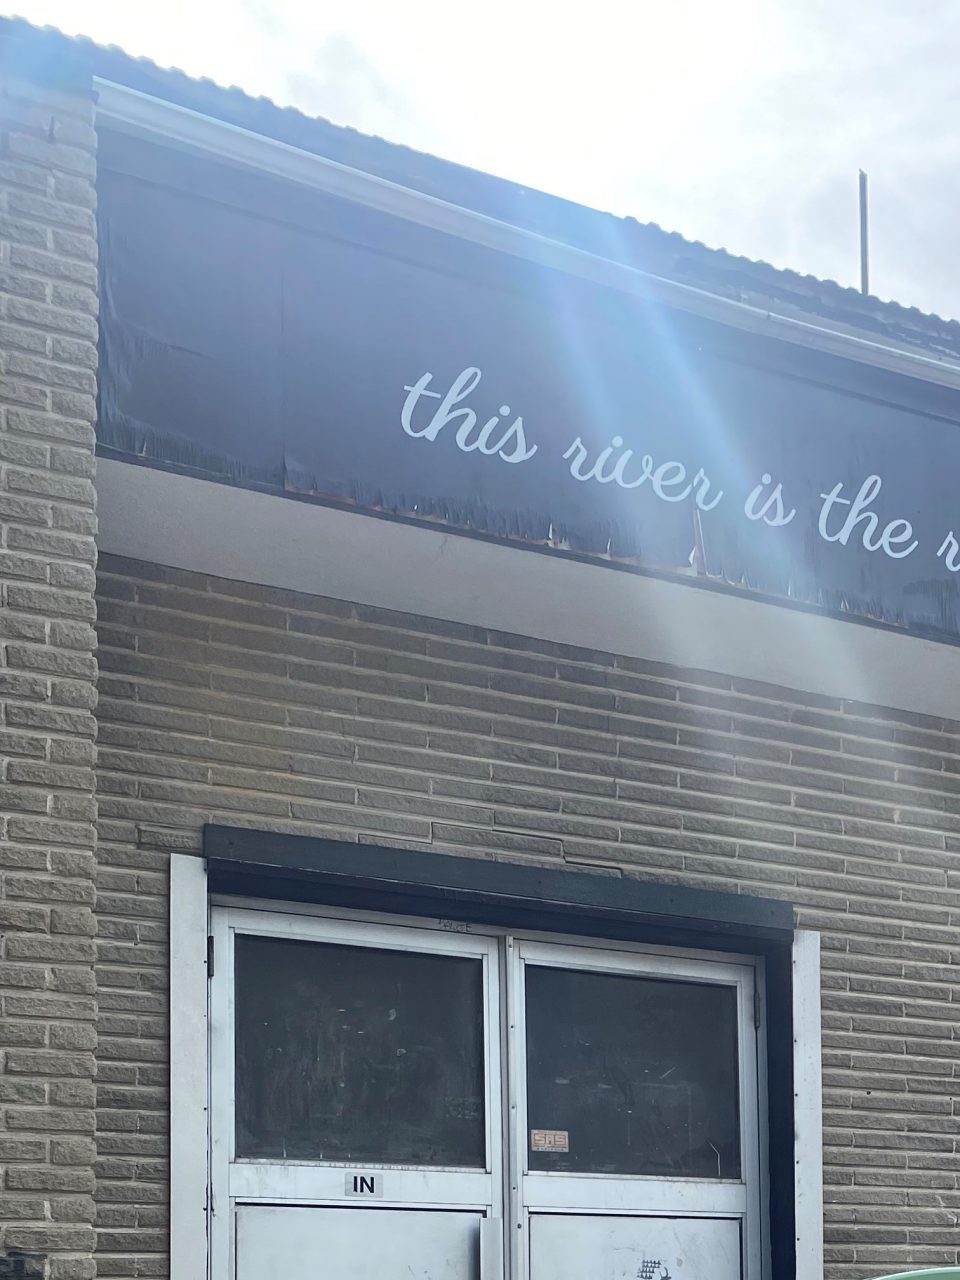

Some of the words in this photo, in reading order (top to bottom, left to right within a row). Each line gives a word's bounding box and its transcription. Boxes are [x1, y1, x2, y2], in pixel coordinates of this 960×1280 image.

[400, 367, 537, 463] this
[563, 436, 723, 511] river
[745, 473, 796, 526] is
[818, 475, 918, 558] the
[353, 1175, 375, 1193] IN
